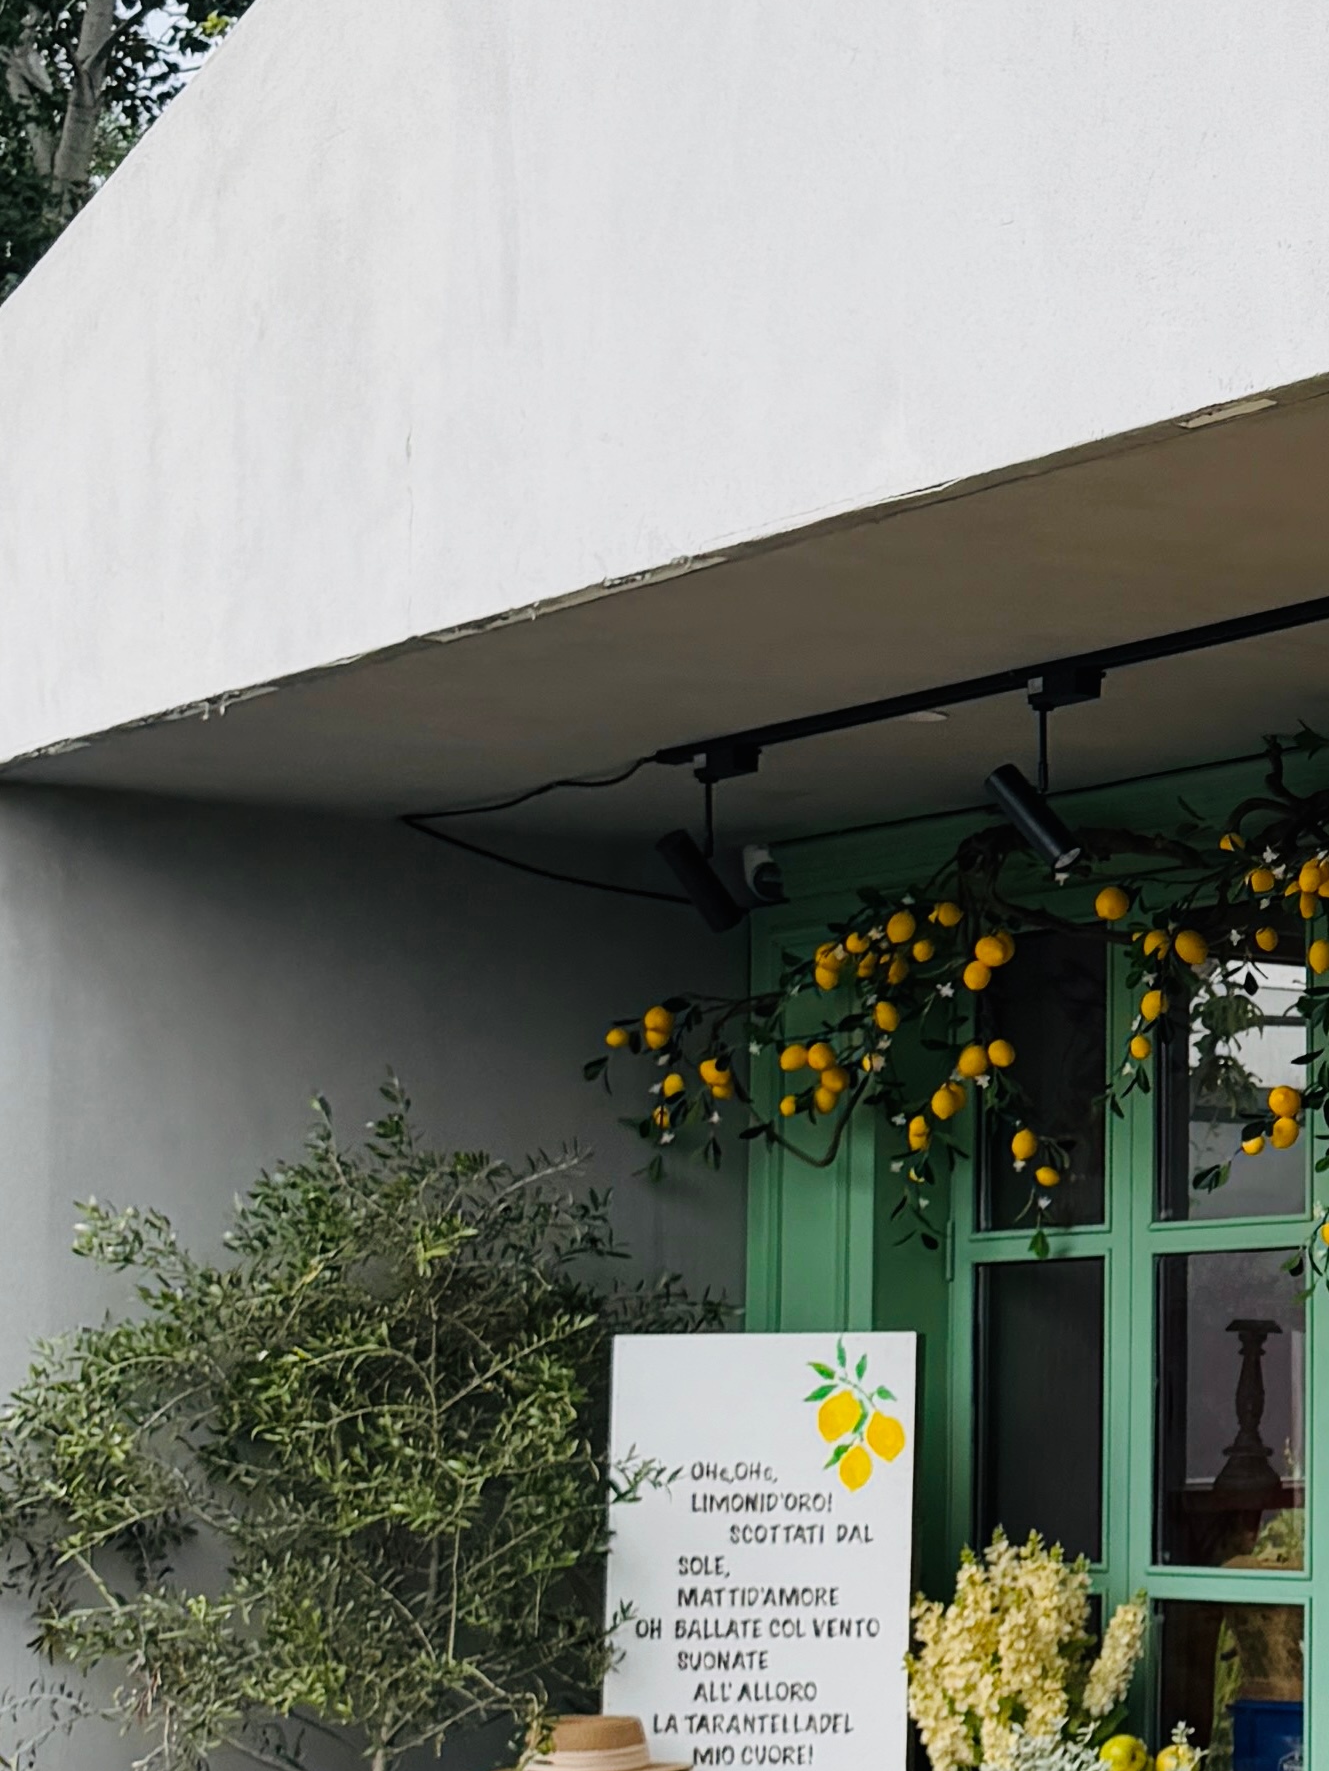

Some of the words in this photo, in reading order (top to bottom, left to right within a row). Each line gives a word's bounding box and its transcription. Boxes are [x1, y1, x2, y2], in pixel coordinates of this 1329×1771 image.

[730, 1524, 824, 1544] SCOTTATI
[837, 1524, 873, 1543] DAL
[678, 1556, 730, 1578] SOLE,
[635, 1618, 662, 1640] OH
[675, 1618, 761, 1640] BALLATE
[769, 1618, 805, 1638] COL
[813, 1618, 880, 1638] VENTO
[678, 1651, 768, 1671] SUONATE
[653, 1714, 678, 1735] LA
[693, 1745, 734, 1767] MIO
[741, 1745, 813, 1765] CUORE!
